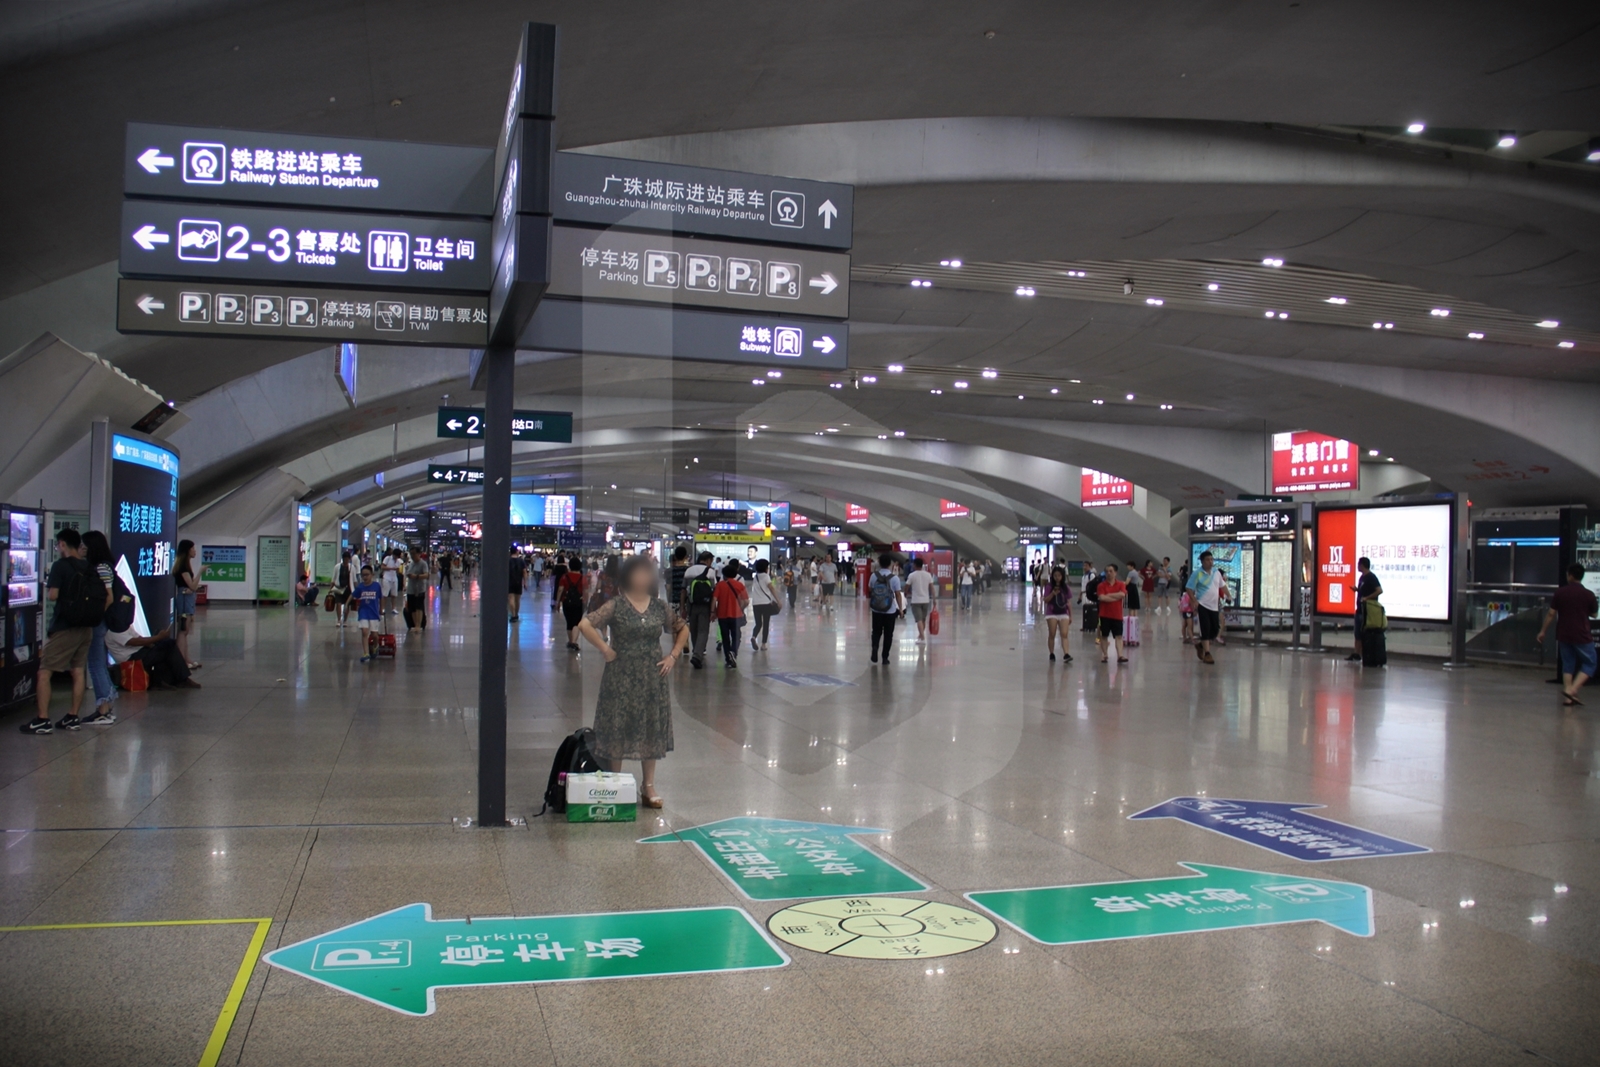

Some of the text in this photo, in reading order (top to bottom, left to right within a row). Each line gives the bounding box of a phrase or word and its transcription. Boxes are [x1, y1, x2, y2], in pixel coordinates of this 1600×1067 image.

[230, 148, 362, 175] 铁路进站乘车
[230, 171, 379, 189] Railway Station Departure
[602, 174, 765, 208] 广珠城际进站乘车
[565, 191, 765, 222] Guangzhou-zhuhai Intercity Railway Departure
[225, 226, 475, 262] 2-3 售票处 卫生间
[295, 251, 443, 271] Tickets Toilet
[580, 246, 639, 271] 停车场
[599, 269, 638, 284] Parking
[322, 301, 371, 318] 停车场
[408, 305, 488, 324] 自助售票处
[321, 317, 430, 331] Parking TVM
[742, 326, 772, 344] 地铁
[739, 341, 771, 353] Subway
[466, 415, 486, 435] 2
[444, 469, 467, 482] 4-7
[119, 501, 163, 535] 装修要健康
[1214, 513, 1268, 526] 西出站口 东出站口
[712, 840, 788, 880] 出租车
[784, 837, 866, 876] 公交车
[842, 899, 872, 907] 西
[1091, 887, 1256, 914] 停车场
[1185, 903, 1274, 915] Parking
[779, 924, 813, 936] 南
[949, 916, 980, 926] 北
[445, 928, 550, 944] Parking
[441, 936, 645, 968] 停车场
[892, 945, 928, 956] 东
